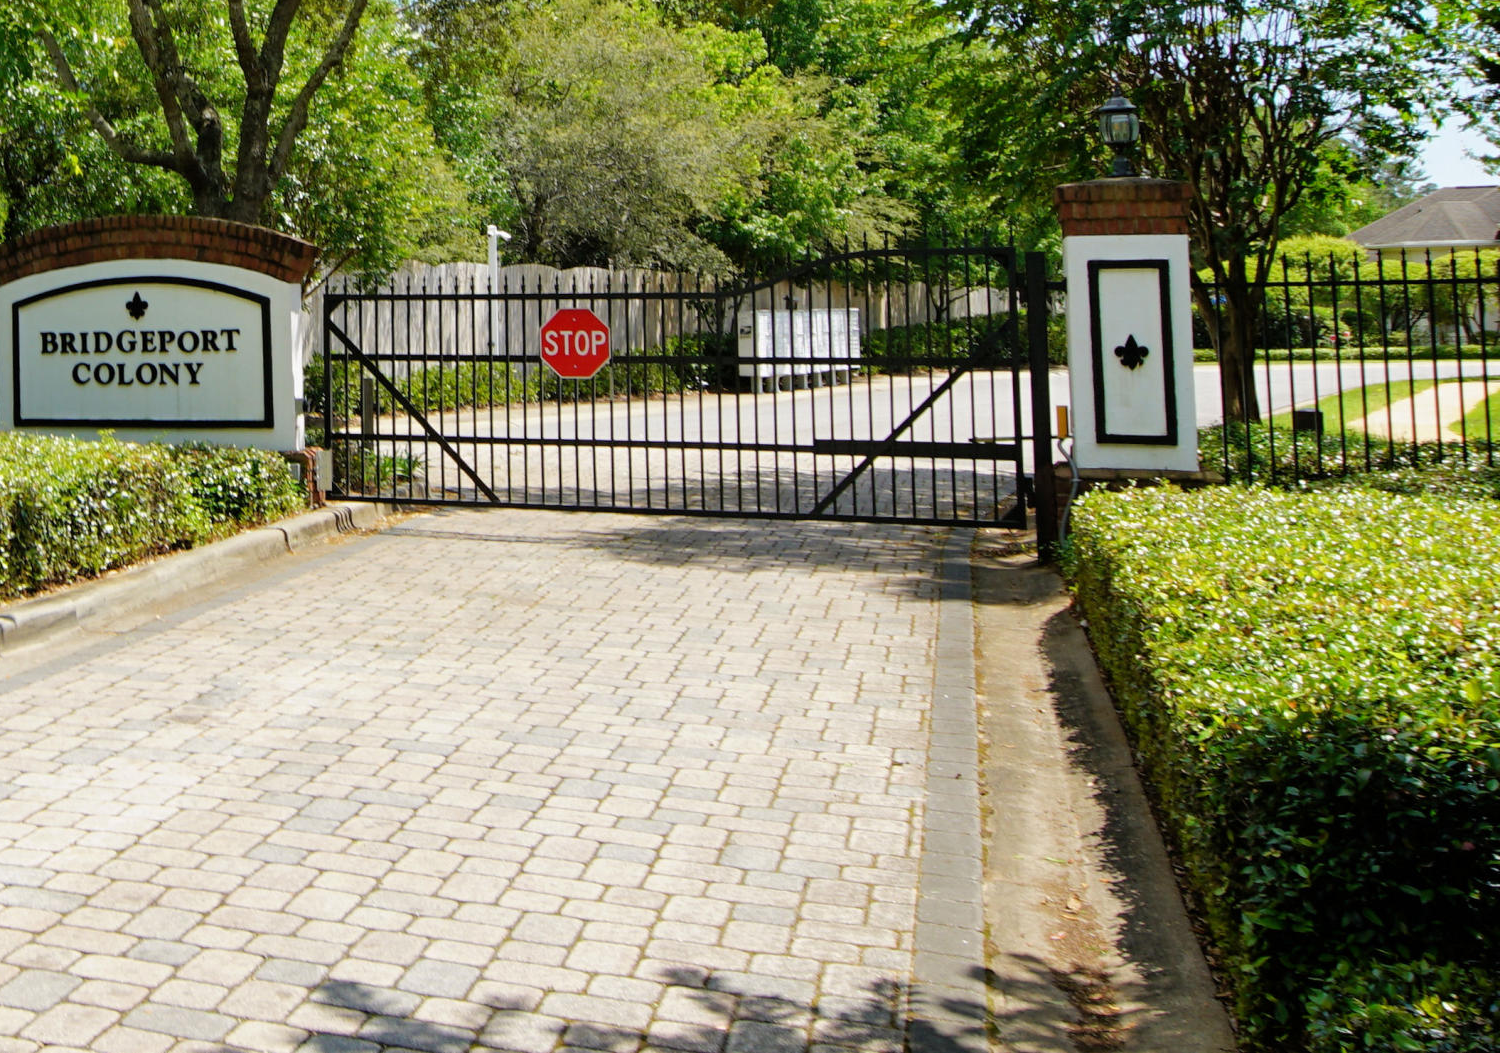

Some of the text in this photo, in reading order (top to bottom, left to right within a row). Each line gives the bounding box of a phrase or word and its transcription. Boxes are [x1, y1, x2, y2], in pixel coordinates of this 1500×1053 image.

[39, 328, 241, 355] BRIDGEPORT
[544, 330, 606, 356] STOP
[71, 362, 204, 386] COLONY
